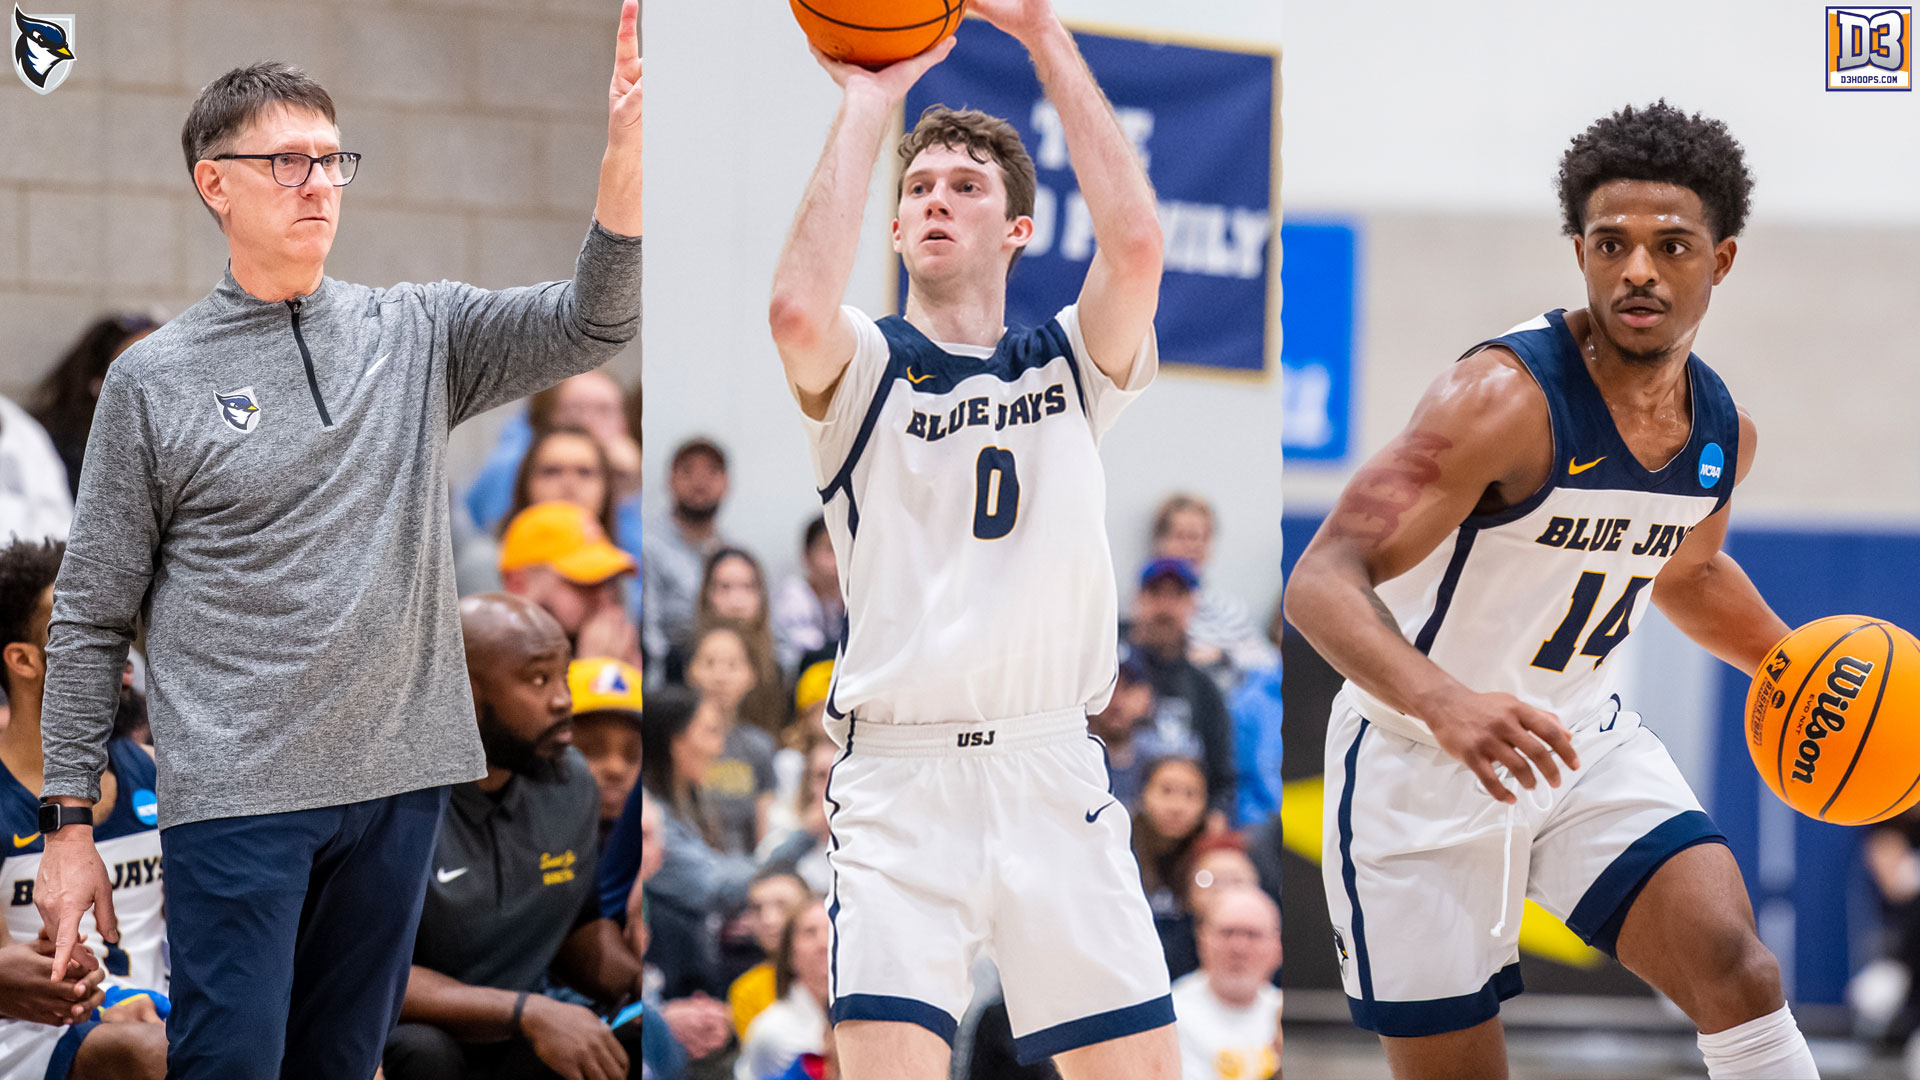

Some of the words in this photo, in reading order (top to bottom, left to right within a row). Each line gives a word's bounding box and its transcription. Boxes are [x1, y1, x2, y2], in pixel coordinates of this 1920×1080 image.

[906, 397, 990, 441] BLUE
[995, 384, 1066, 431] JAYS
[973, 445, 1021, 540] 0
[1700, 463, 1721, 479] NCAA
[1535, 516, 1631, 552] BLUE
[1632, 523, 1694, 558] JAY
[1529, 570, 1654, 673] 14
[1792, 656, 1875, 784] Wilson
[1803, 693, 1816, 713] EVO
[957, 730, 996, 748] USJ
